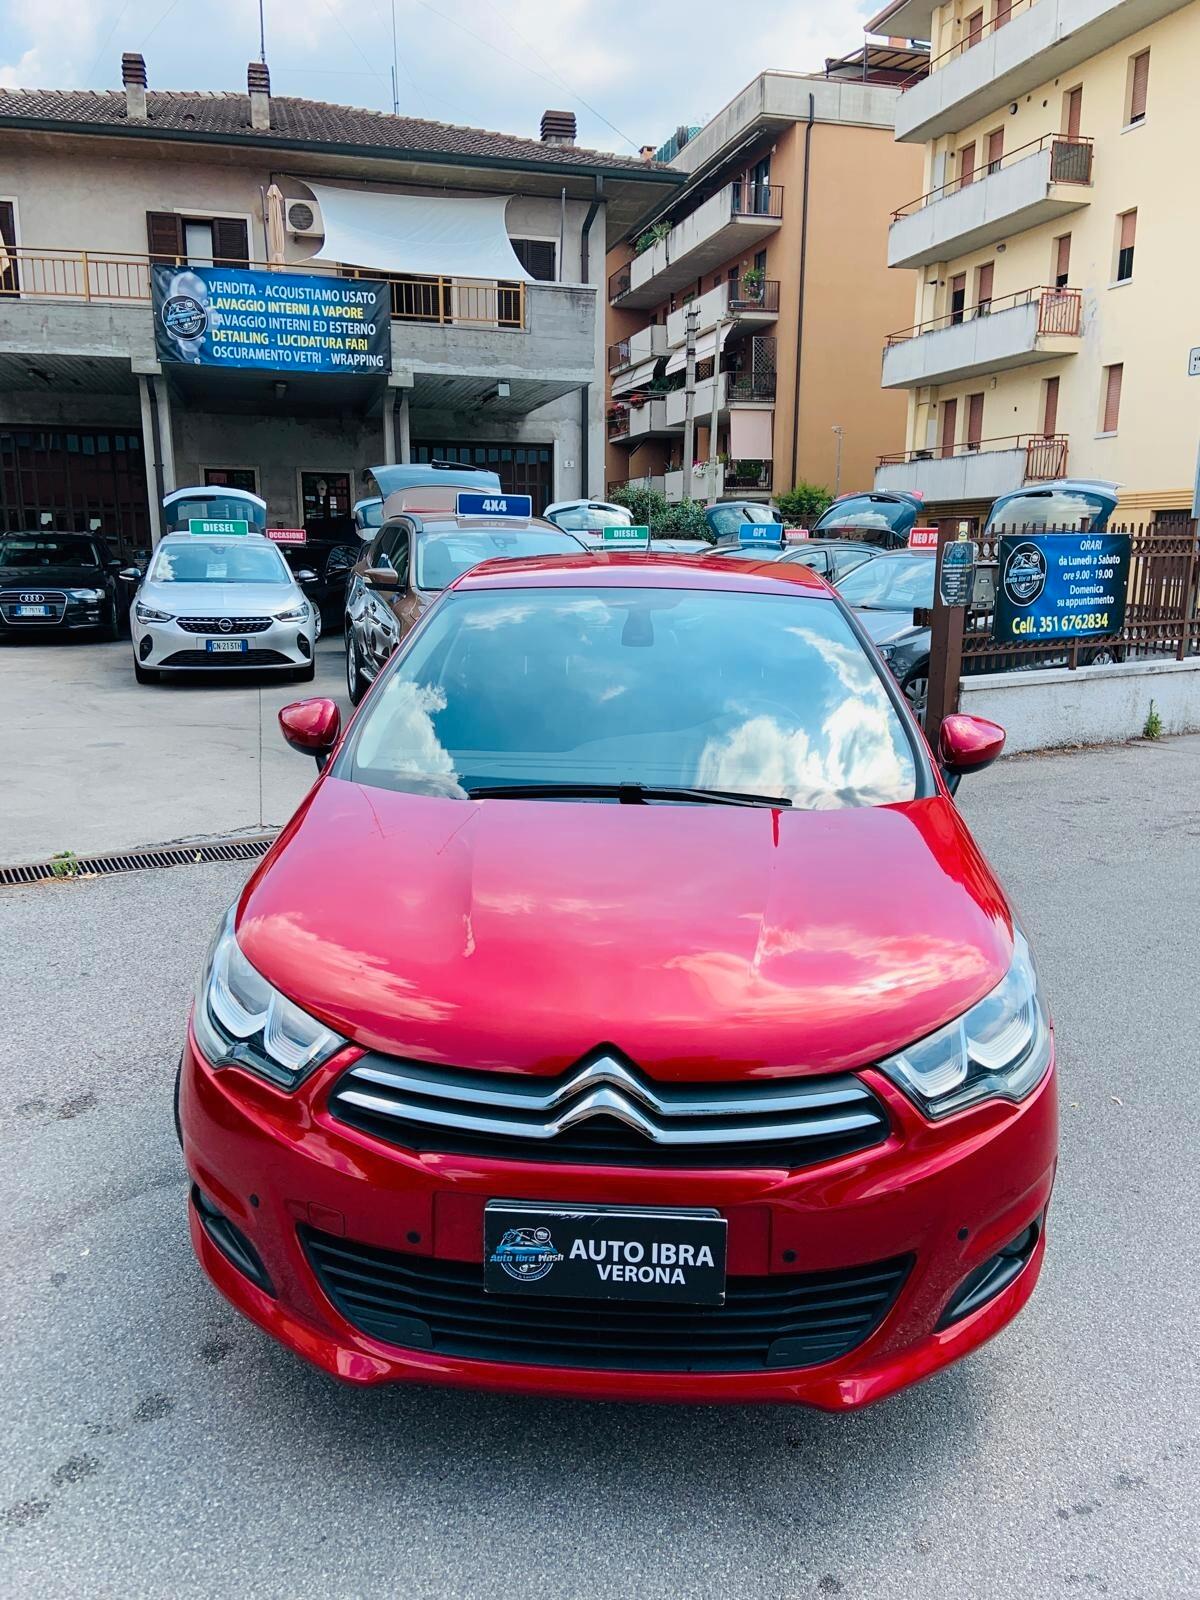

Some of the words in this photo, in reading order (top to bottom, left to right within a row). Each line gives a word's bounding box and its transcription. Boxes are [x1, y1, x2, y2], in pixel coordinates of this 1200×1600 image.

[209, 281, 257, 296] VENDITA
[265, 285, 340, 302] ACQUISTIAMO
[342, 290, 376, 304] USATO
[209, 297, 266, 313] LAVAGGIO
[268, 301, 310, 316] INTERNI
[312, 304, 320, 316] A
[322, 305, 364, 320] VAPORE
[211, 314, 267, 329] LAVAGGIO
[268, 318, 311, 332] INTERNI
[313, 320, 327, 333] ED
[330, 322, 376, 336] ESTERNO
[212, 330, 269, 345] DETAILING
[277, 334, 343, 349] LUCIDATURA
[345, 338, 368, 351] FARI
[213, 346, 292, 361] OSCURAMENTO
[293, 350, 322, 364] VETRI
[331, 353, 384, 367] WRAPPING
[203, 522, 235, 533] DIESEL
[613, 529, 639, 538] DIESEL
[752, 528, 767, 537] GPL
[268, 531, 304, 539] OCCASIONE
[912, 532, 928, 544] NEO
[928, 532, 938, 544] PA
[1080, 539, 1103, 551] ORARI
[1058, 555, 1068, 566] da
[1092, 557, 1098, 565] a
[1098, 553, 1121, 566] Sabato
[1063, 572, 1075, 581] ore
[1075, 570, 1090, 580] 9.00
[1095, 569, 1113, 580] 19.00
[1069, 584, 1104, 595] Domenica
[1057, 599, 1064, 607] su
[1064, 595, 1115, 609] appuntamento
[1012, 615, 1037, 635] Cell.
[1039, 616, 1059, 633] 351
[1061, 612, 1109, 631] 6762834
[569, 1238, 645, 1264] AUTO
[652, 1242, 715, 1267] IBRA
[597, 1263, 686, 1285] VERONA
